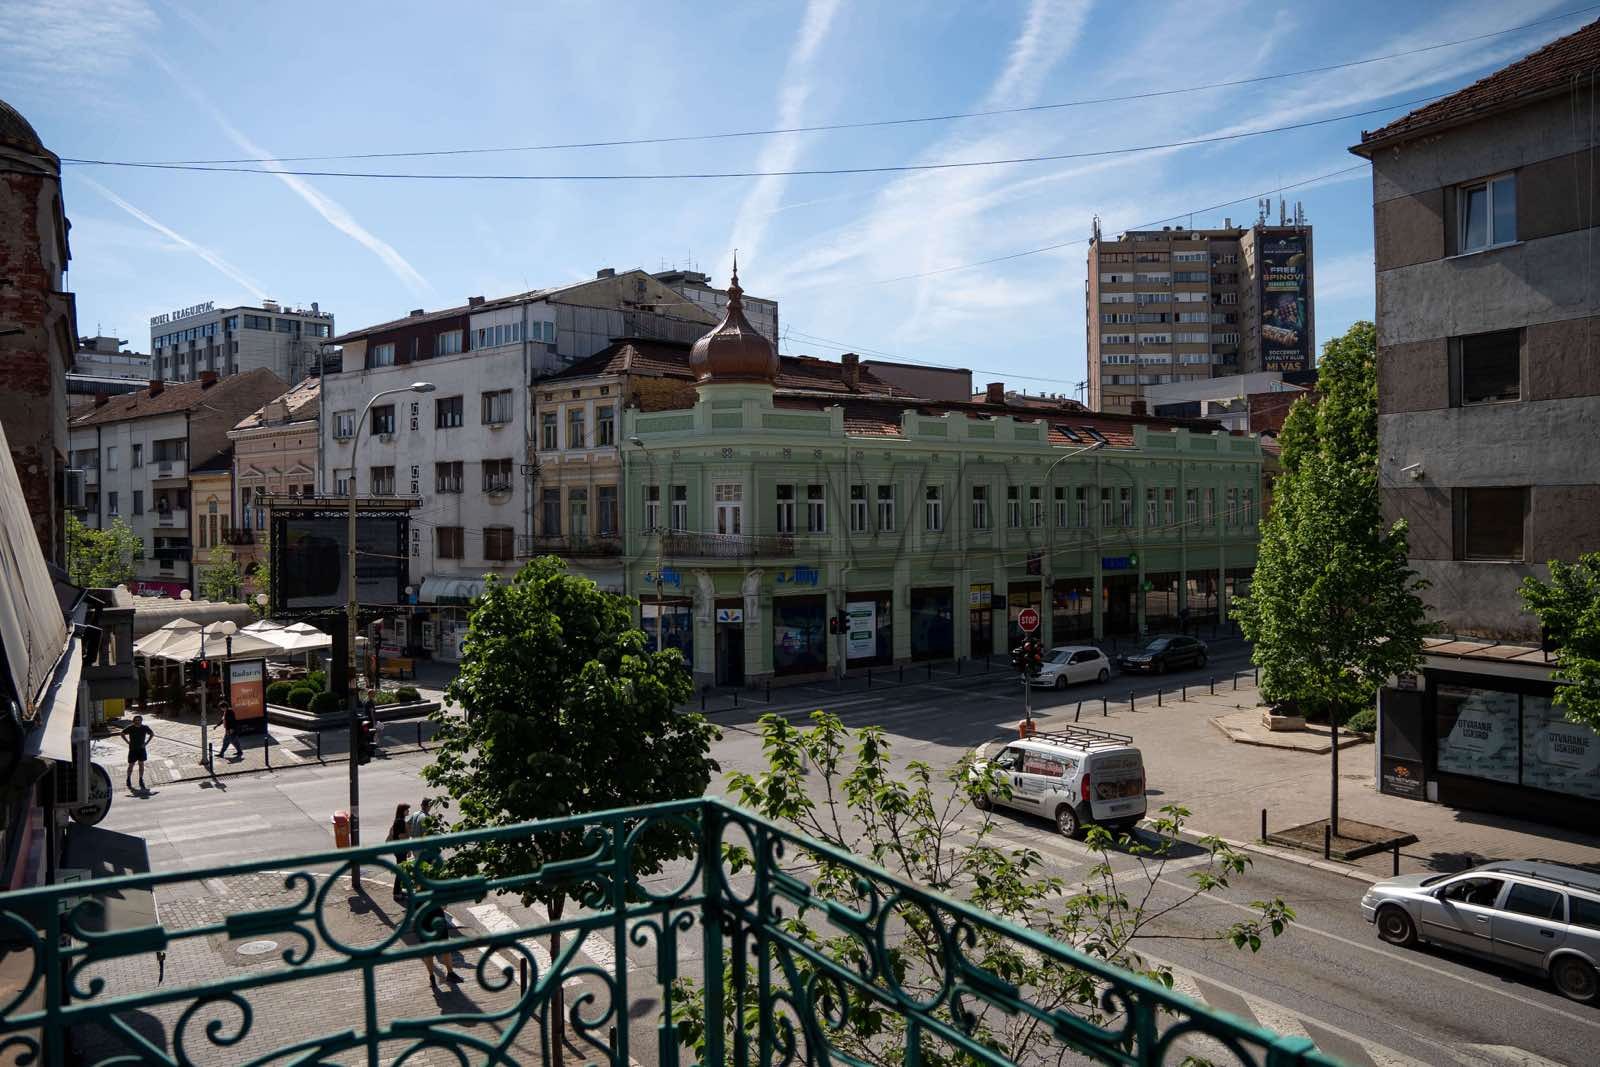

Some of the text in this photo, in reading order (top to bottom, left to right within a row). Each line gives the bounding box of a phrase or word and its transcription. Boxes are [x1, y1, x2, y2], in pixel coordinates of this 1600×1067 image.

[150, 312, 170, 326] HOTEL
[1021, 615, 1038, 625] STOP
[1458, 719, 1493, 732] OTVARANJE
[1547, 732, 1591, 747] OTVARANJE
